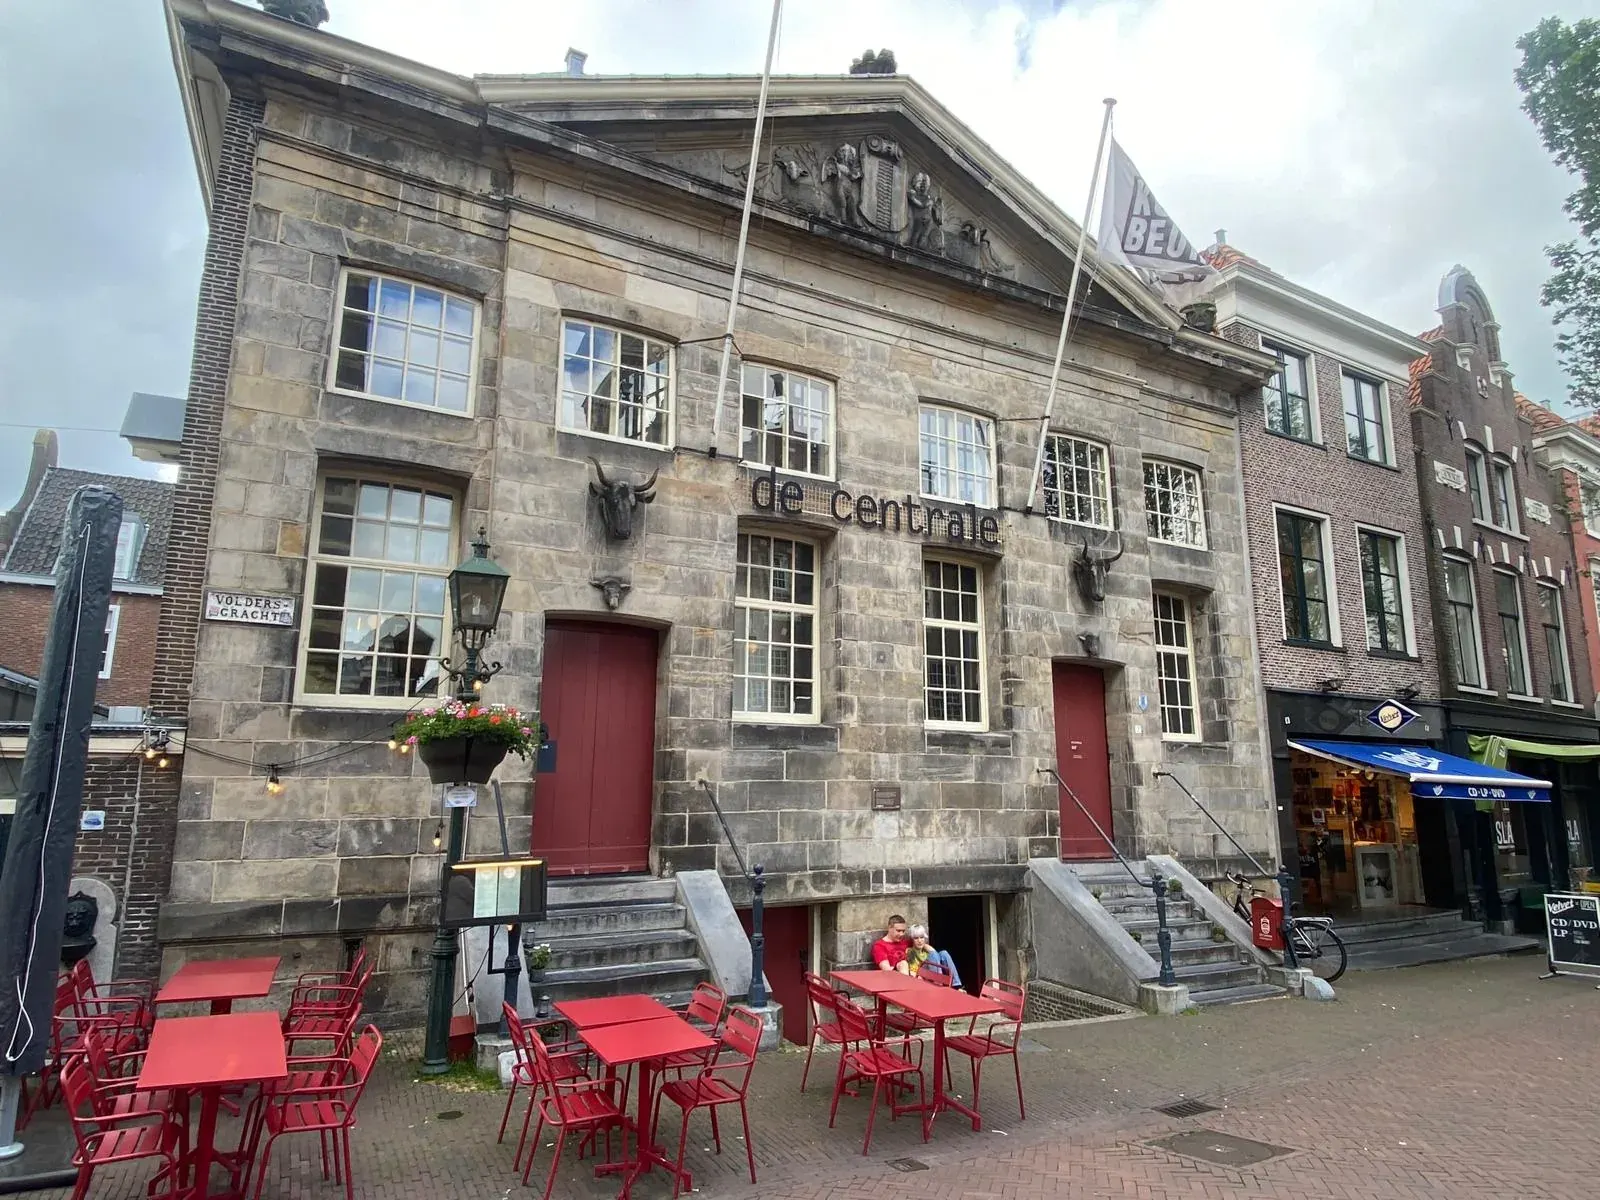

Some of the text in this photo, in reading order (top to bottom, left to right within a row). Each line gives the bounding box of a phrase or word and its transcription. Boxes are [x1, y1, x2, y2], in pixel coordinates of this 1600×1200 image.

[752, 467, 999, 545] de centrale
[215, 594, 288, 610] VOLDERS-
[220, 608, 280, 621] GRACHT
[1495, 821, 1515, 845] SLA
[1548, 899, 1574, 914] Velvet
[1553, 928, 1569, 938] LP
